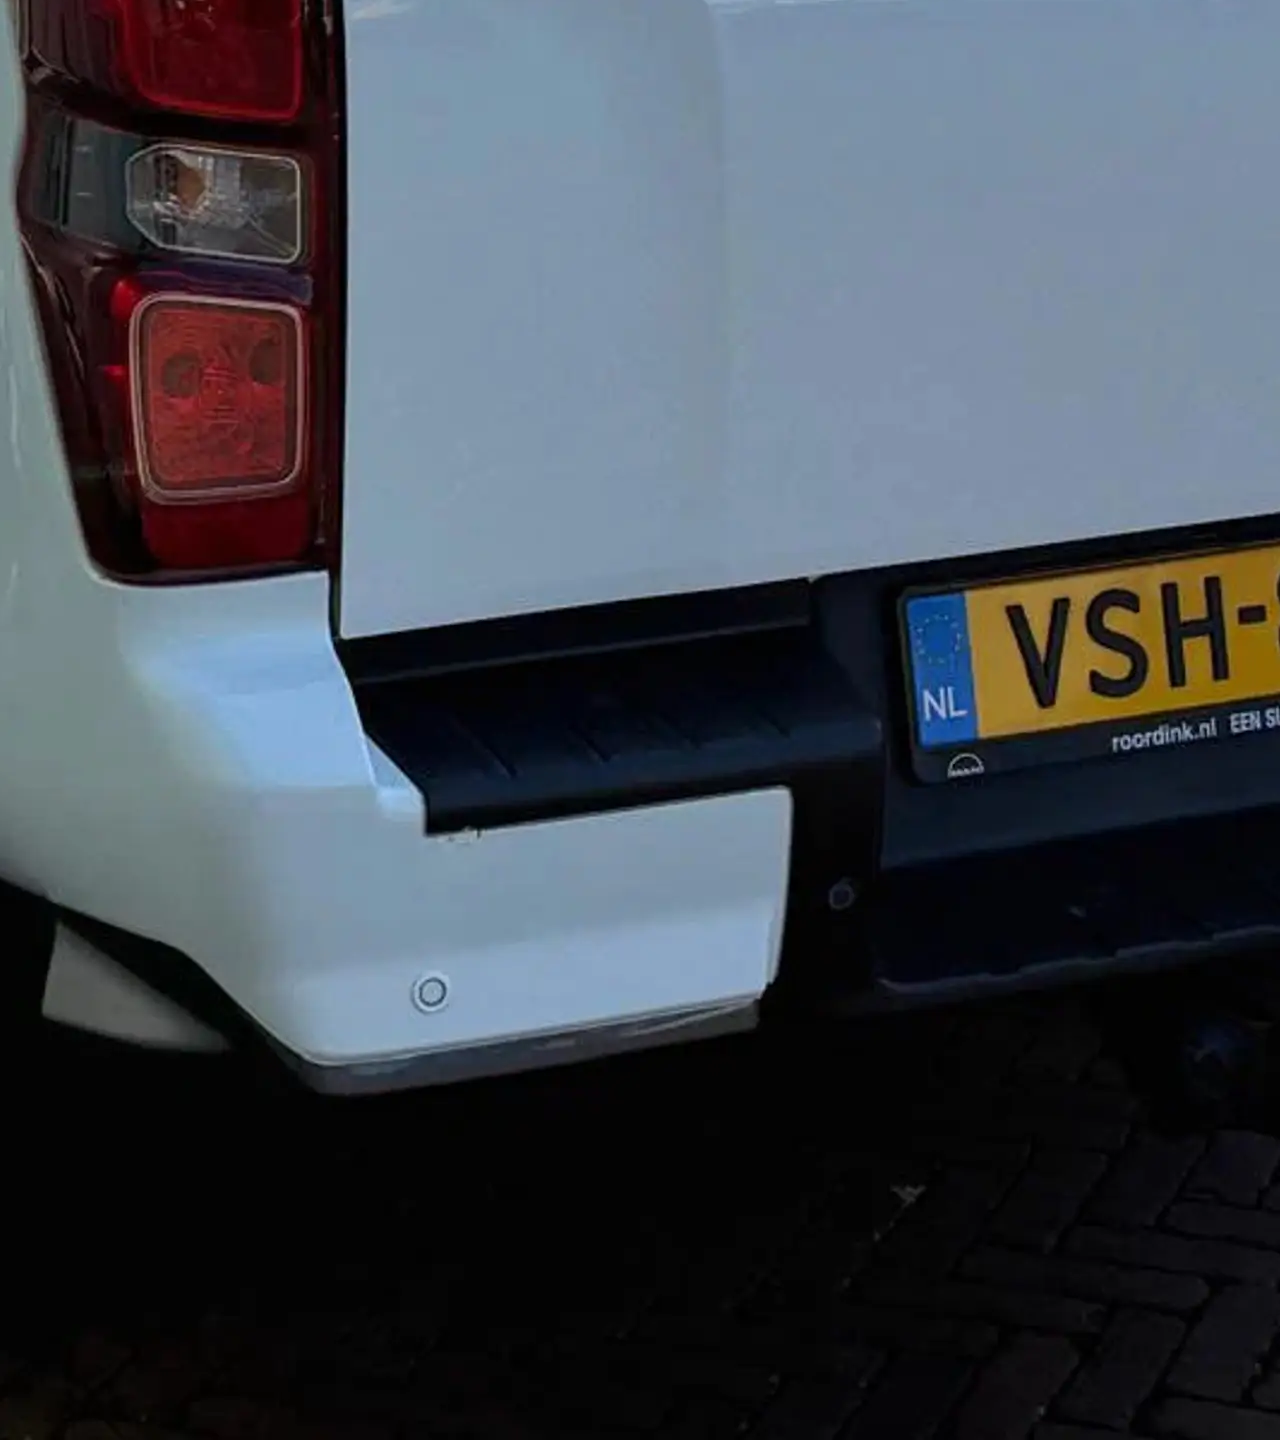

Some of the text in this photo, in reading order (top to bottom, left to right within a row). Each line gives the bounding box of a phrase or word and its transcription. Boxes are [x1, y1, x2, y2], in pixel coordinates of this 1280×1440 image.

[923, 687, 968, 722] NL
[1112, 717, 1217, 752] roordink.nl
[1230, 710, 1261, 734] EEN
